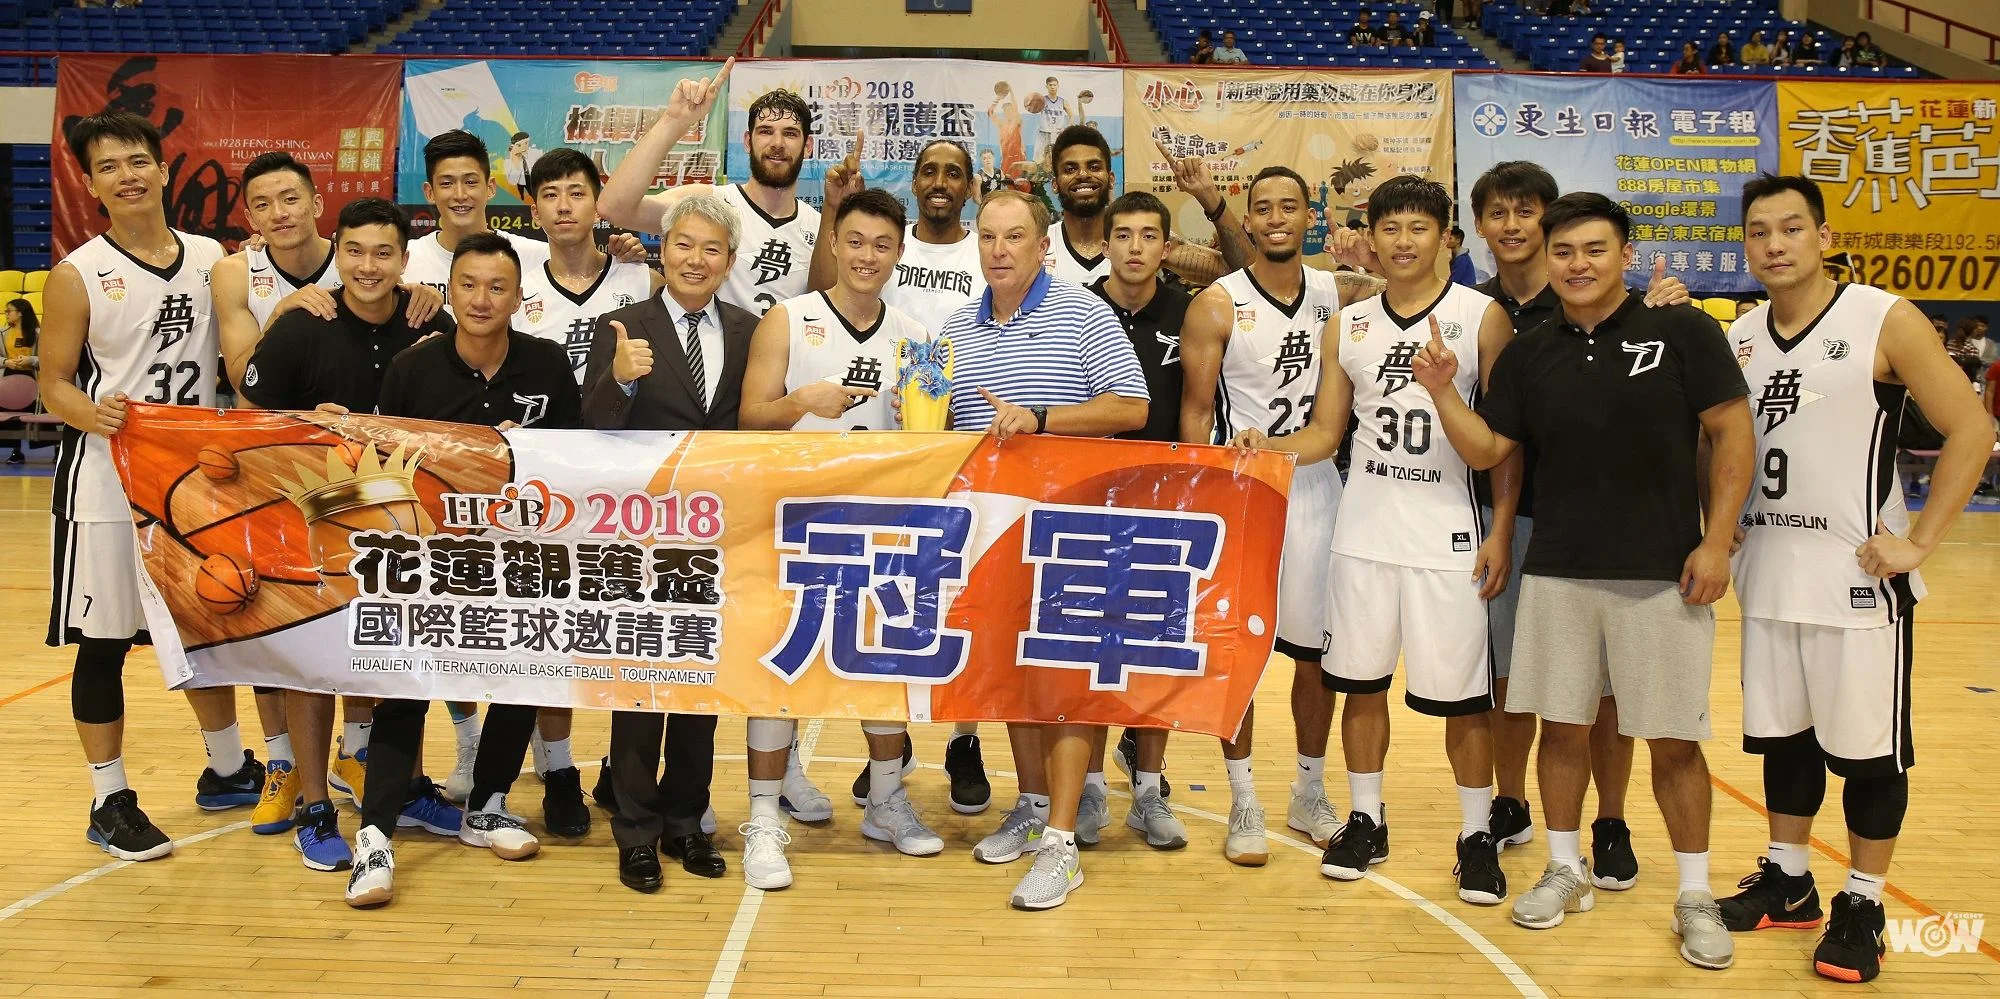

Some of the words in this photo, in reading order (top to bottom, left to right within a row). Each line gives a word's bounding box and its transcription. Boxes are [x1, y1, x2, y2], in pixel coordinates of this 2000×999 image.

[866, 81, 915, 99] 2018
[1514, 104, 1660, 138] 更生日報
[1670, 109, 1757, 135] 電子報
[219, 138, 241, 148] 1928
[243, 138, 273, 149] FENG
[275, 139, 310, 149] SHING
[289, 151, 334, 160] TAIWAN
[1615, 154, 1757, 174] 花蓮OPEN購物網
[1617, 178, 1721, 195] 888房屋市集
[1619, 200, 1717, 218] Google環景
[1629, 250, 1750, 273] 供您專業服
[102, 278, 126, 291] ABL
[253, 275, 274, 285] ABL
[526, 301, 544, 313] ABL
[806, 326, 825, 335] ABL
[1352, 322, 1369, 331] ABL
[144, 360, 201, 405] 32
[1267, 394, 1316, 438] 23
[1375, 406, 1431, 455] 30
[1365, 459, 1388, 477] 泰山
[1390, 465, 1442, 483] TAISUN
[1761, 447, 1788, 500] 9
[586, 493, 721, 539] 2018
[1767, 512, 1828, 530] TAISUN
[353, 533, 720, 604] 花蓮觀護盃
[82, 594, 93, 618] 7
[760, 497, 1226, 692] 冠軍
[354, 602, 718, 661] 國際籃球邀請賽
[351, 658, 413, 672] HUALIEN
[421, 660, 526, 676] INTERNATIONAL
[529, 664, 614, 681] BASKETBALL
[620, 668, 715, 685] TOURNAMENT
